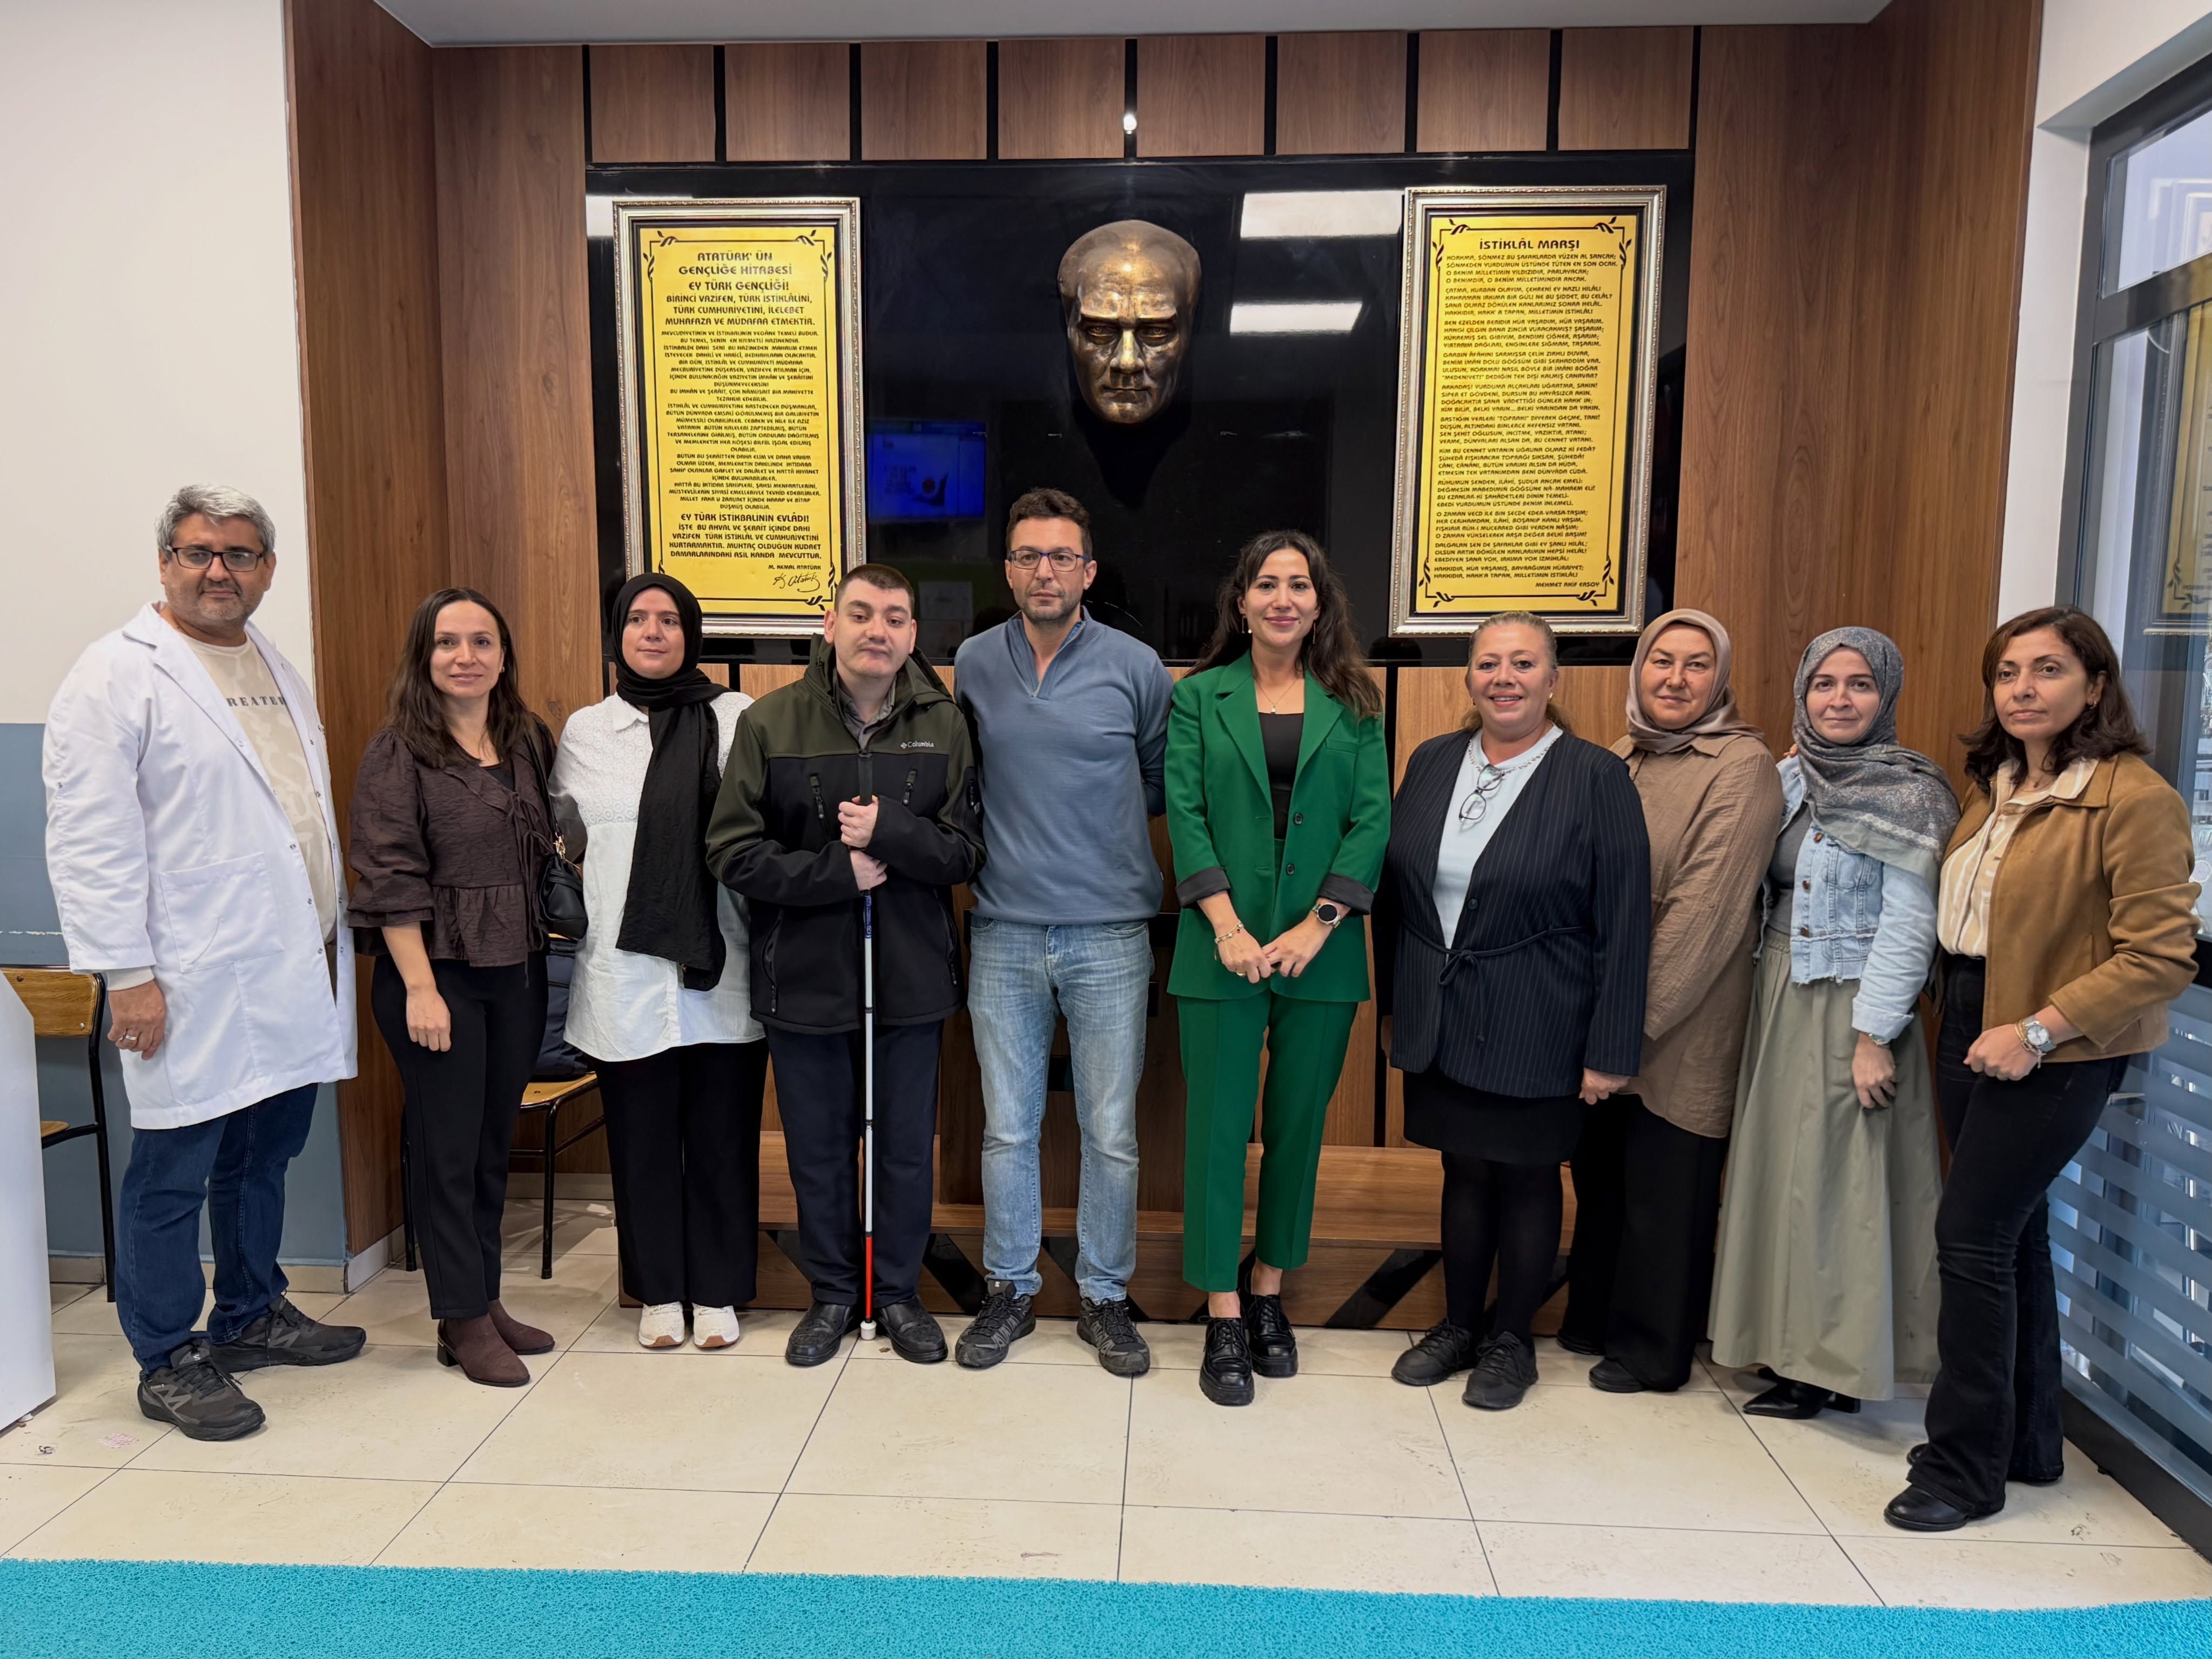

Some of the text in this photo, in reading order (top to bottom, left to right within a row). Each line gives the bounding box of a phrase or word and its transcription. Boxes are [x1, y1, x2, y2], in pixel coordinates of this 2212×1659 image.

[1480, 238, 1580, 251] İSTİKLÂL MARŞI
[756, 250, 772, 260] ÜN
[678, 264, 791, 276] GENÇLİĞE HİTABESİ
[689, 279, 789, 292] EY TÜRK GENÇLİĞİ!
[666, 293, 812, 303] BİRİNCİ VAZİFEN, TÜRK İSTİKLÂLİNİ,
[673, 304, 804, 314] TÜRK CUMHURİYETİNİ, İLELEBET
[727, 315, 768, 325] MÜDAFAA
[771, 316, 815, 325] ETMEKTİR.
[694, 511, 716, 521] TÜRK
[719, 512, 774, 521] İSTİKBALİNİN
[777, 512, 809, 522] EVLÂDI!
[678, 522, 693, 531] İŞTE
[769, 523, 791, 532] İÇİNDE
